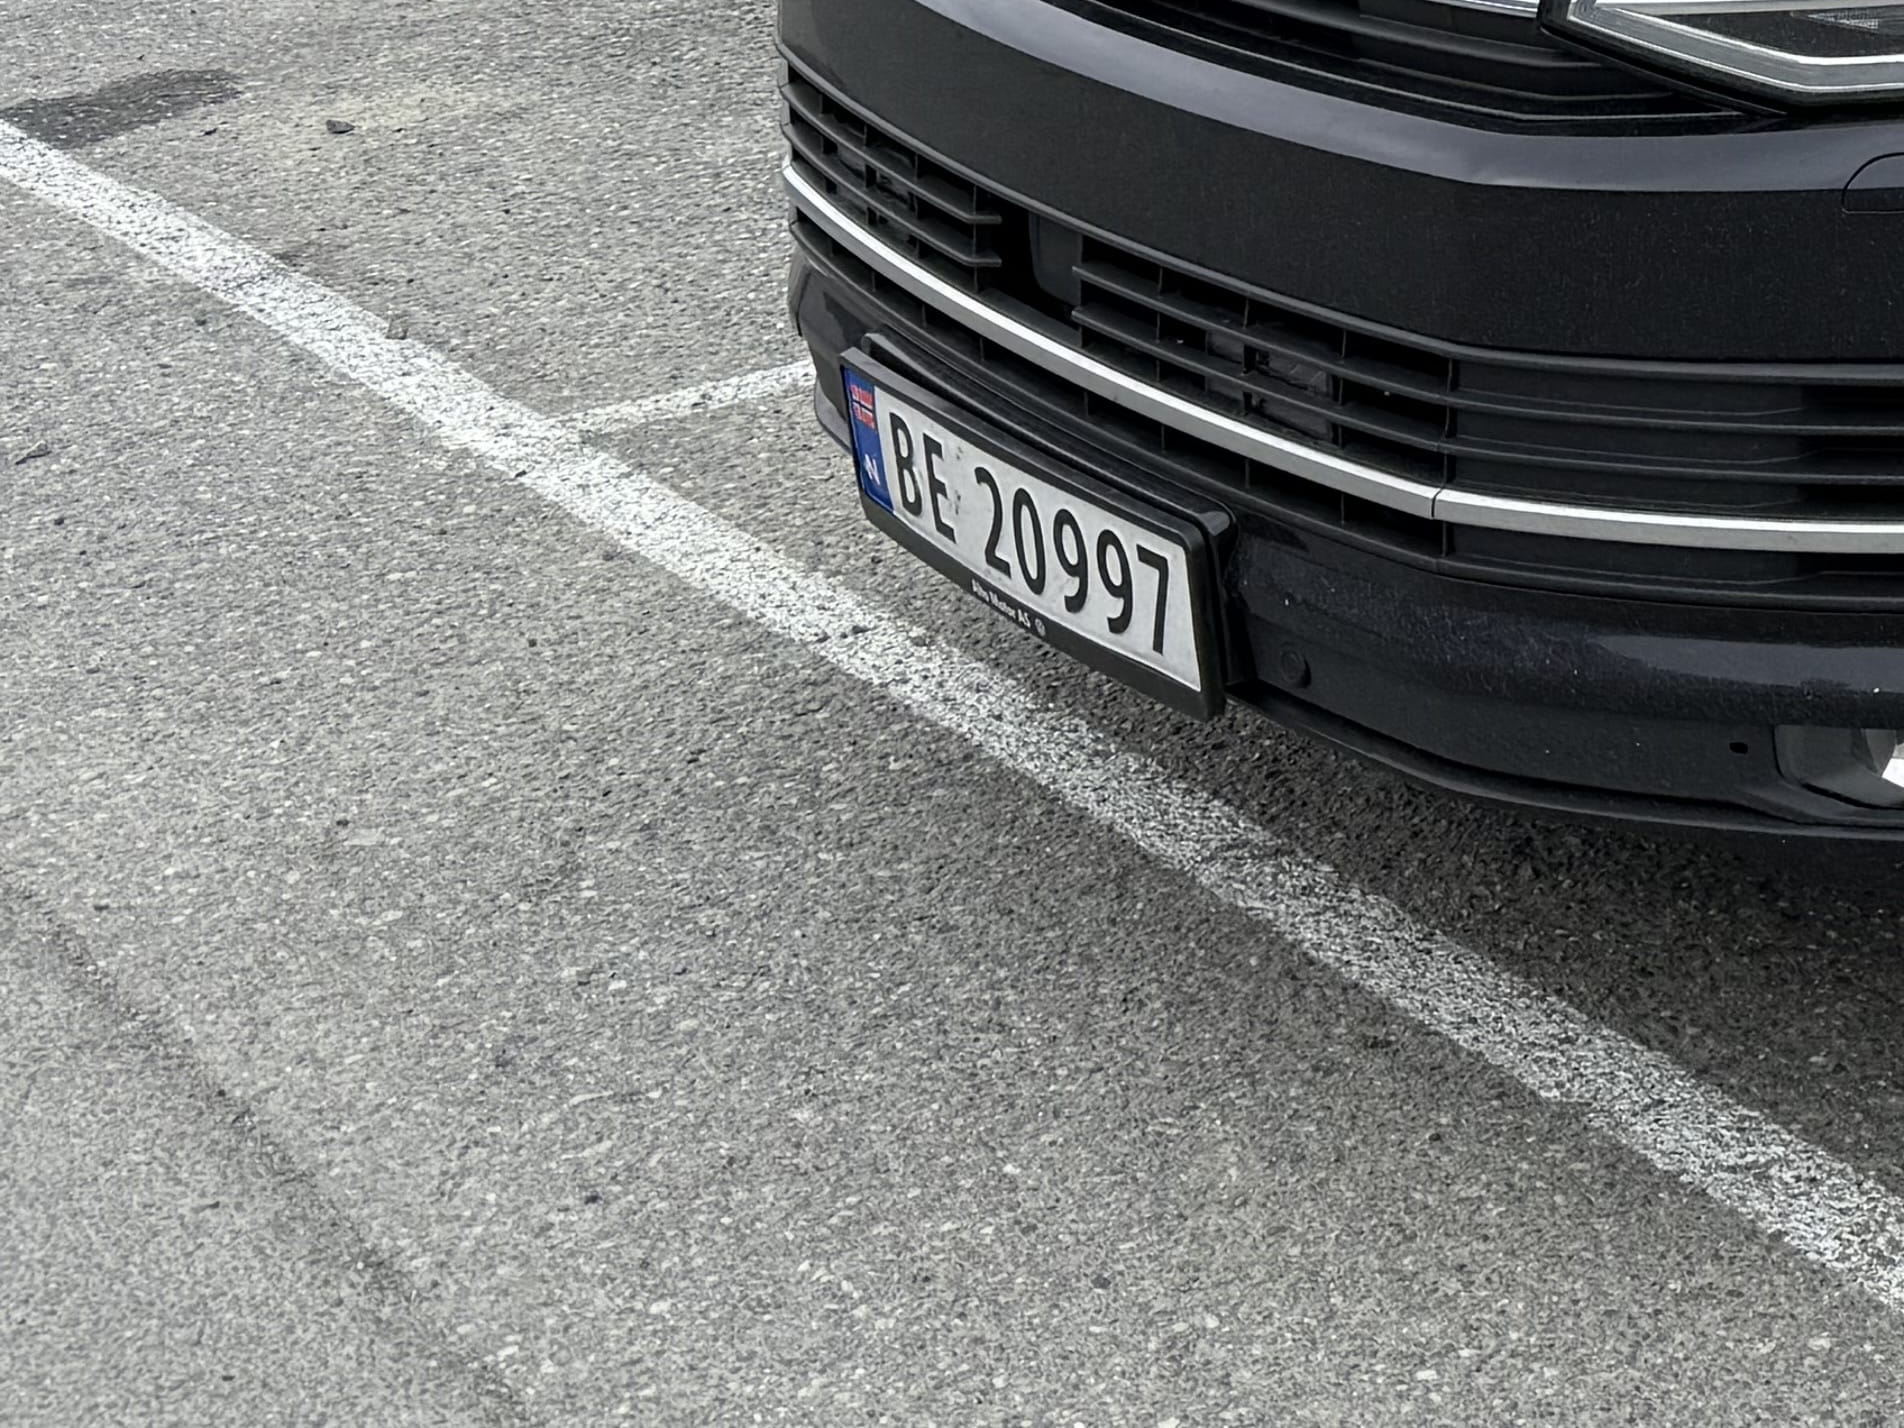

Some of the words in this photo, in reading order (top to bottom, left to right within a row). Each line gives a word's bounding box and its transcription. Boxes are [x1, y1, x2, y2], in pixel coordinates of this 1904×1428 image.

[865, 452, 881, 486] N
[889, 411, 957, 545] BE
[974, 466, 1170, 656] 20997
